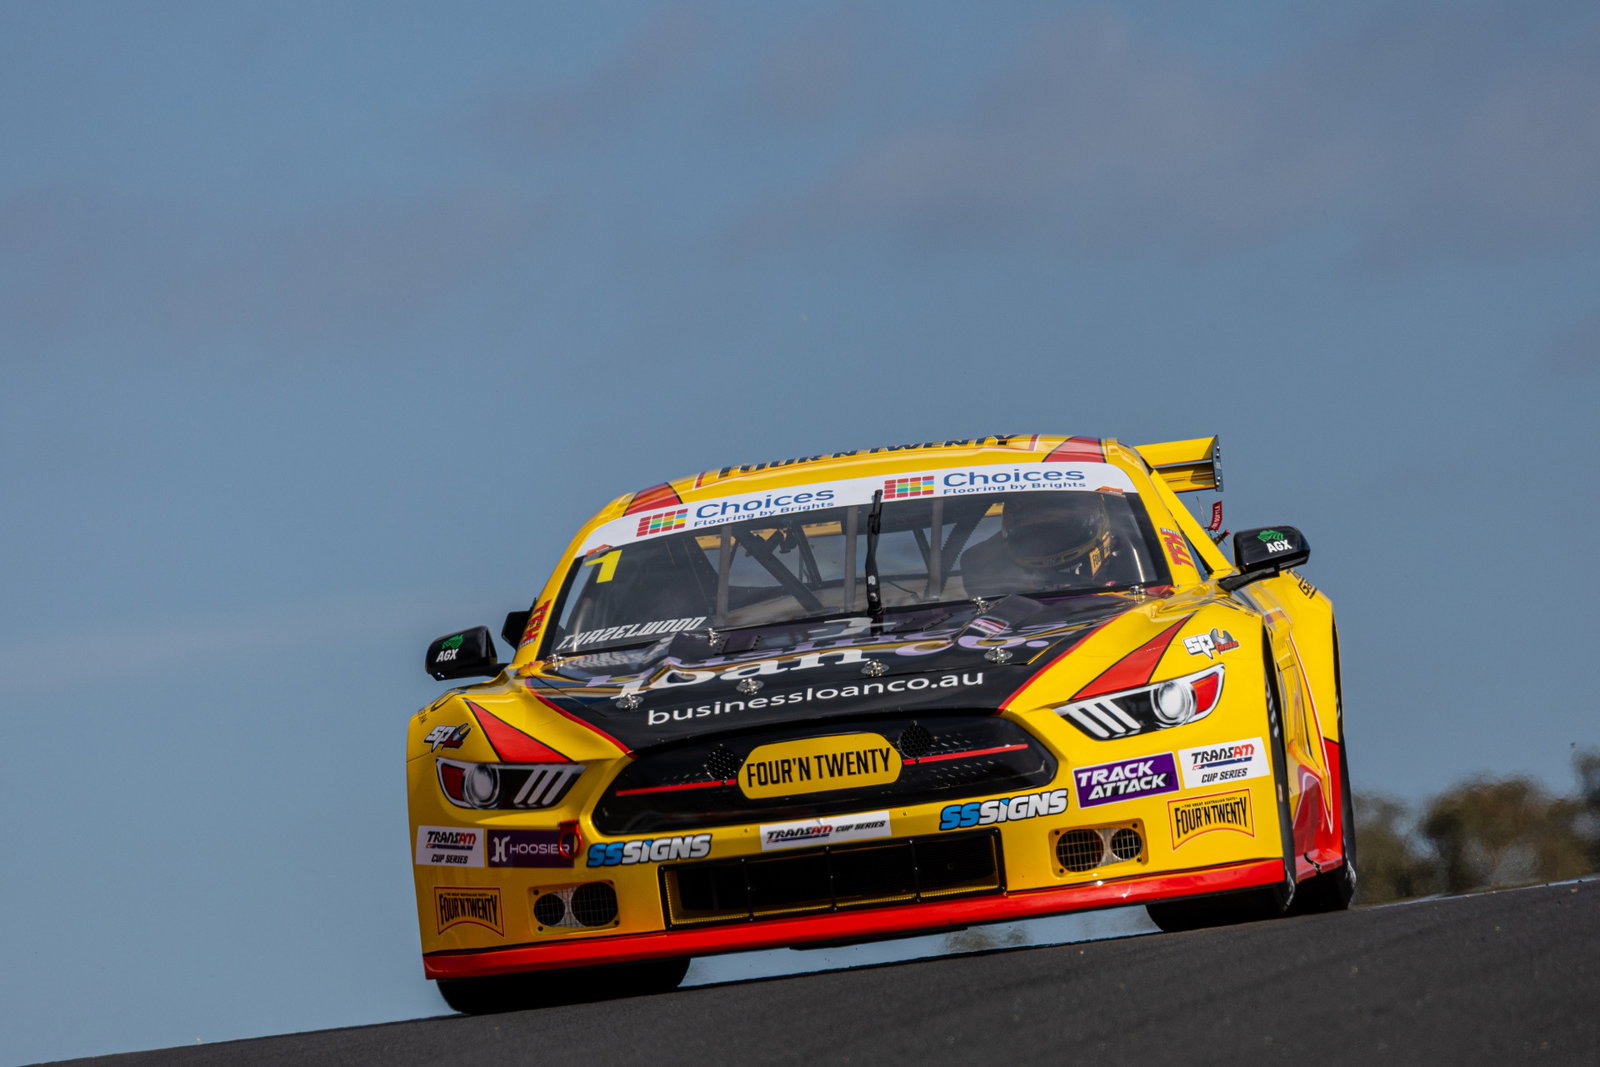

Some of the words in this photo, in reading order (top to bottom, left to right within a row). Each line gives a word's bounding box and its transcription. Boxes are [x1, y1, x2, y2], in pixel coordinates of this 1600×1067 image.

[943, 468, 1085, 488] Choices
[943, 485, 1006, 495] Flooring
[1010, 483, 1029, 492] by
[1032, 480, 1087, 490] Brights
[694, 512, 755, 528] Flooring
[760, 509, 777, 518] by
[780, 501, 835, 514] Brights
[695, 489, 835, 519] Choices
[1266, 539, 1293, 554] AGX
[584, 549, 623, 584] 1
[436, 648, 460, 663] AGX
[647, 672, 984, 726] businessloanco.au
[1191, 743, 1255, 765] TRANSAM
[747, 756, 811, 788] FOUR'N
[817, 747, 891, 779] TWENTY
[1077, 760, 1154, 788] TRACK
[1201, 772, 1218, 783] CUP
[1220, 767, 1248, 781] SERIES
[1087, 773, 1168, 801] ATTACK
[1174, 805, 1211, 839] FOUR'N
[1211, 796, 1247, 828] TWENTY
[427, 831, 477, 844] TRANSAM
[766, 824, 833, 840] TRANSAM
[835, 824, 853, 833] CUP
[854, 820, 886, 830] SERIES
[431, 853, 444, 863] CUP
[445, 854, 469, 865] SERIES
[465, 894, 498, 927] TWENTY
